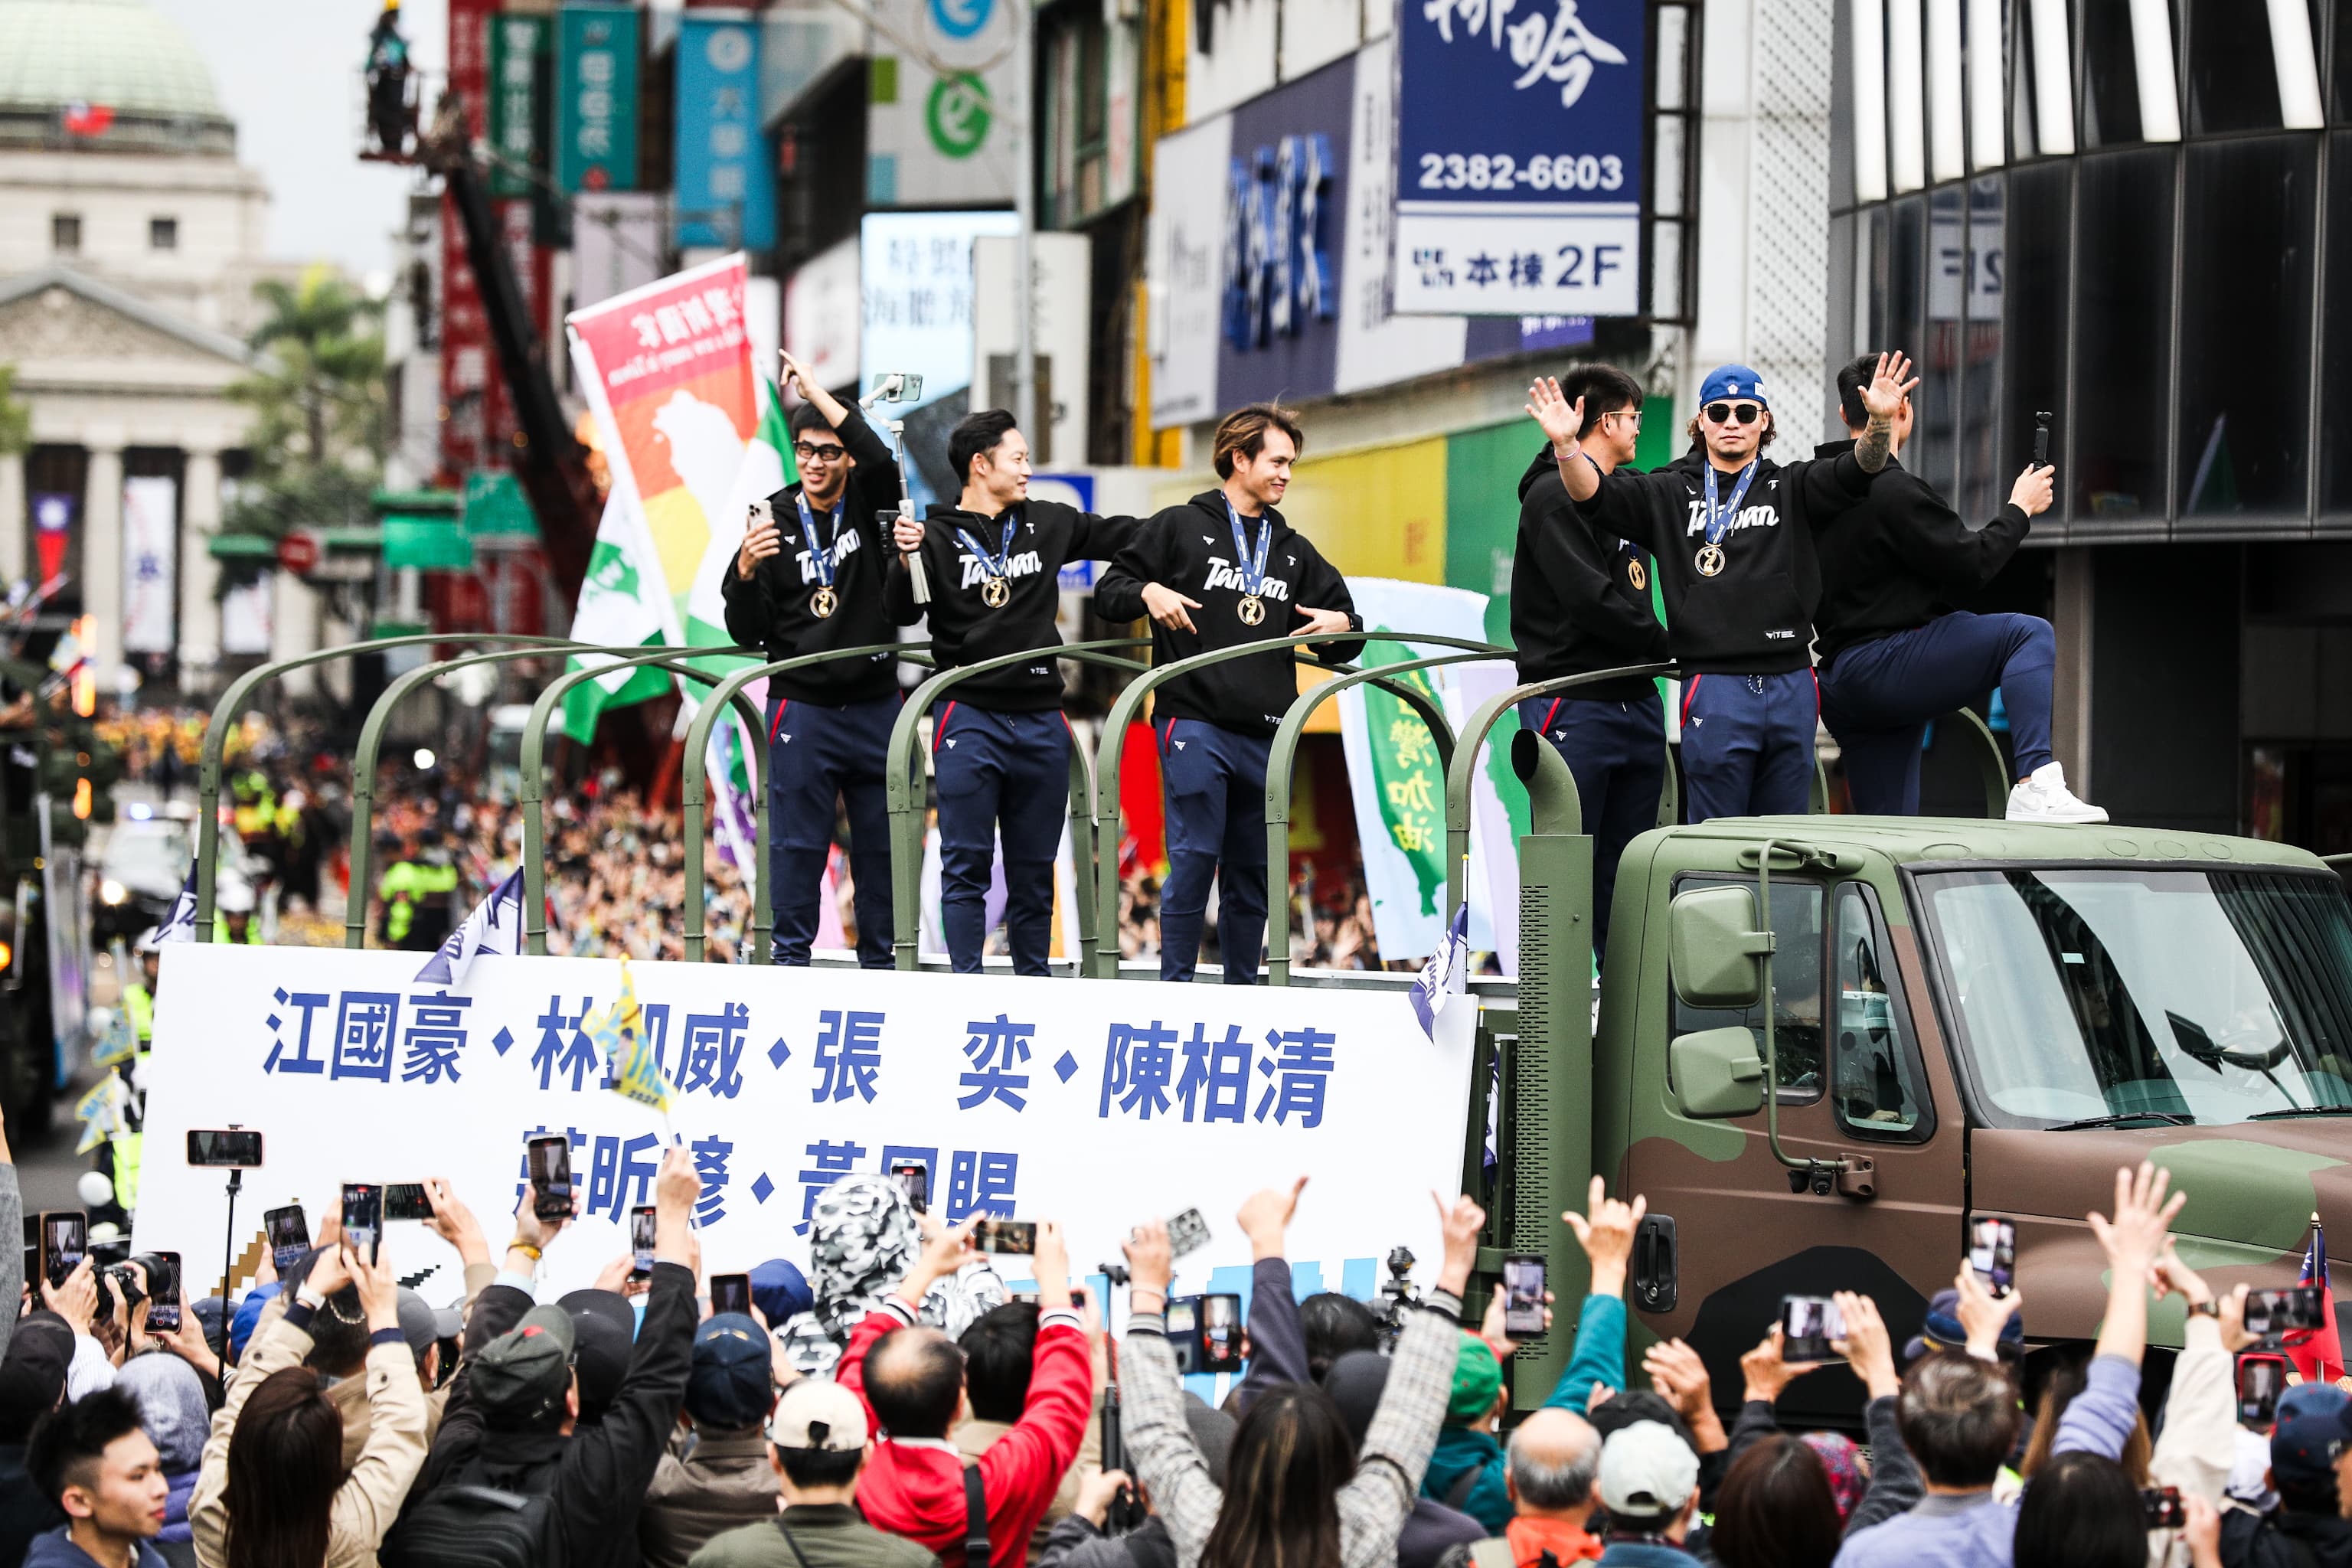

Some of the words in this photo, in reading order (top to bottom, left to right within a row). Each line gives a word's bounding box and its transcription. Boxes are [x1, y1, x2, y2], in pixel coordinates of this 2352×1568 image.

[1419, 152, 1625, 191] 2382-6603
[1465, 250, 1545, 289] 本棟
[1556, 244, 1623, 288] 2F
[1203, 555, 1290, 603] Taian
[263, 986, 473, 1084] 江國豪
[812, 1010, 886, 1104] 張
[957, 1014, 1037, 1113] 奕
[1099, 1020, 1338, 1129] 陳柏清
